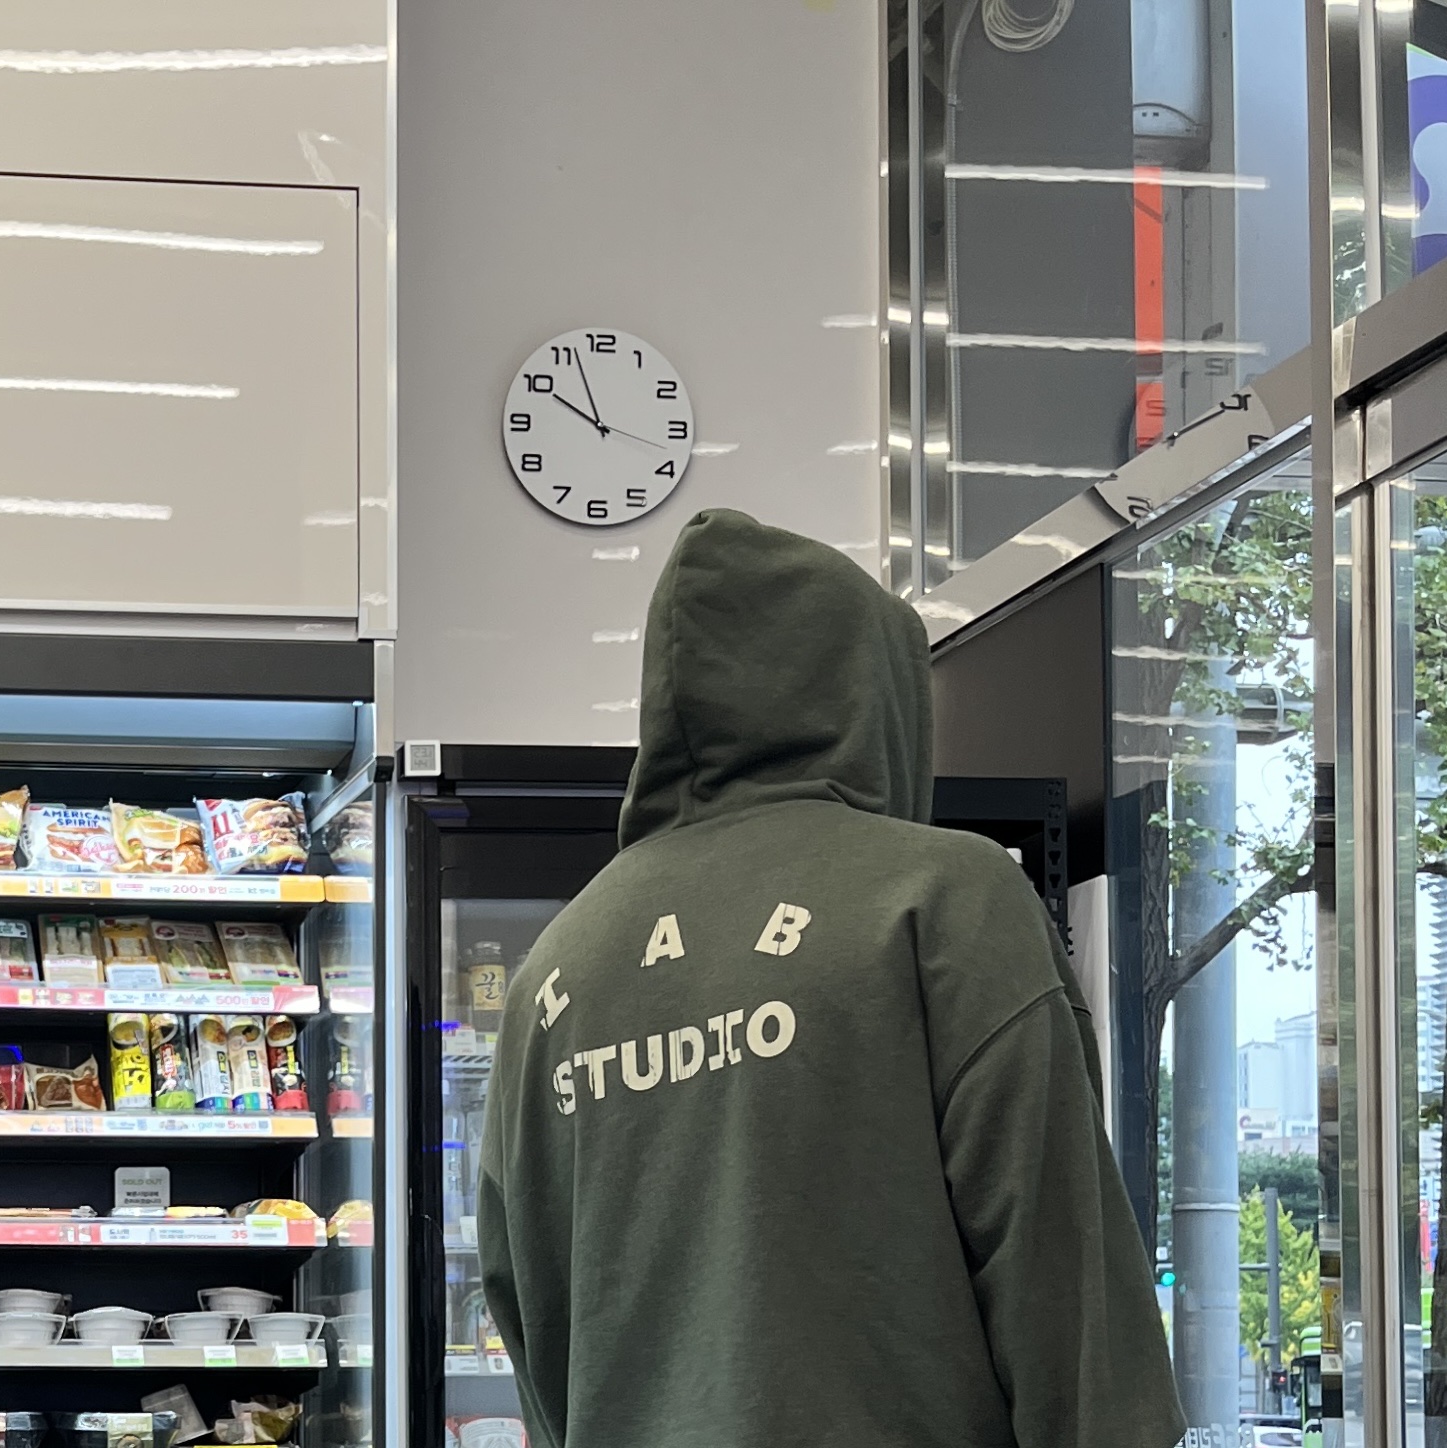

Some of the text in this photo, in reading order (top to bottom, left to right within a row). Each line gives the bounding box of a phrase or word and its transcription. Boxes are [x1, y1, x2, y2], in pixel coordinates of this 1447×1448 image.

[586, 333, 617, 353] 12
[551, 346, 573, 365] 11
[633, 350, 643, 369] 1
[523, 373, 554, 393] 10
[657, 380, 678, 399] 2
[510, 413, 532, 432] 9
[667, 420, 688, 440] 3
[521, 453, 543, 472] 8
[655, 460, 676, 479] 4
[552, 485, 572, 504] 7
[626, 488, 648, 507] 5
[587, 500, 609, 519] 6
[56, 817, 101, 828] SPIRIT
[553, 1000, 797, 1116] STUDIO
[122, 1178, 163, 1186] SOLD OUT
